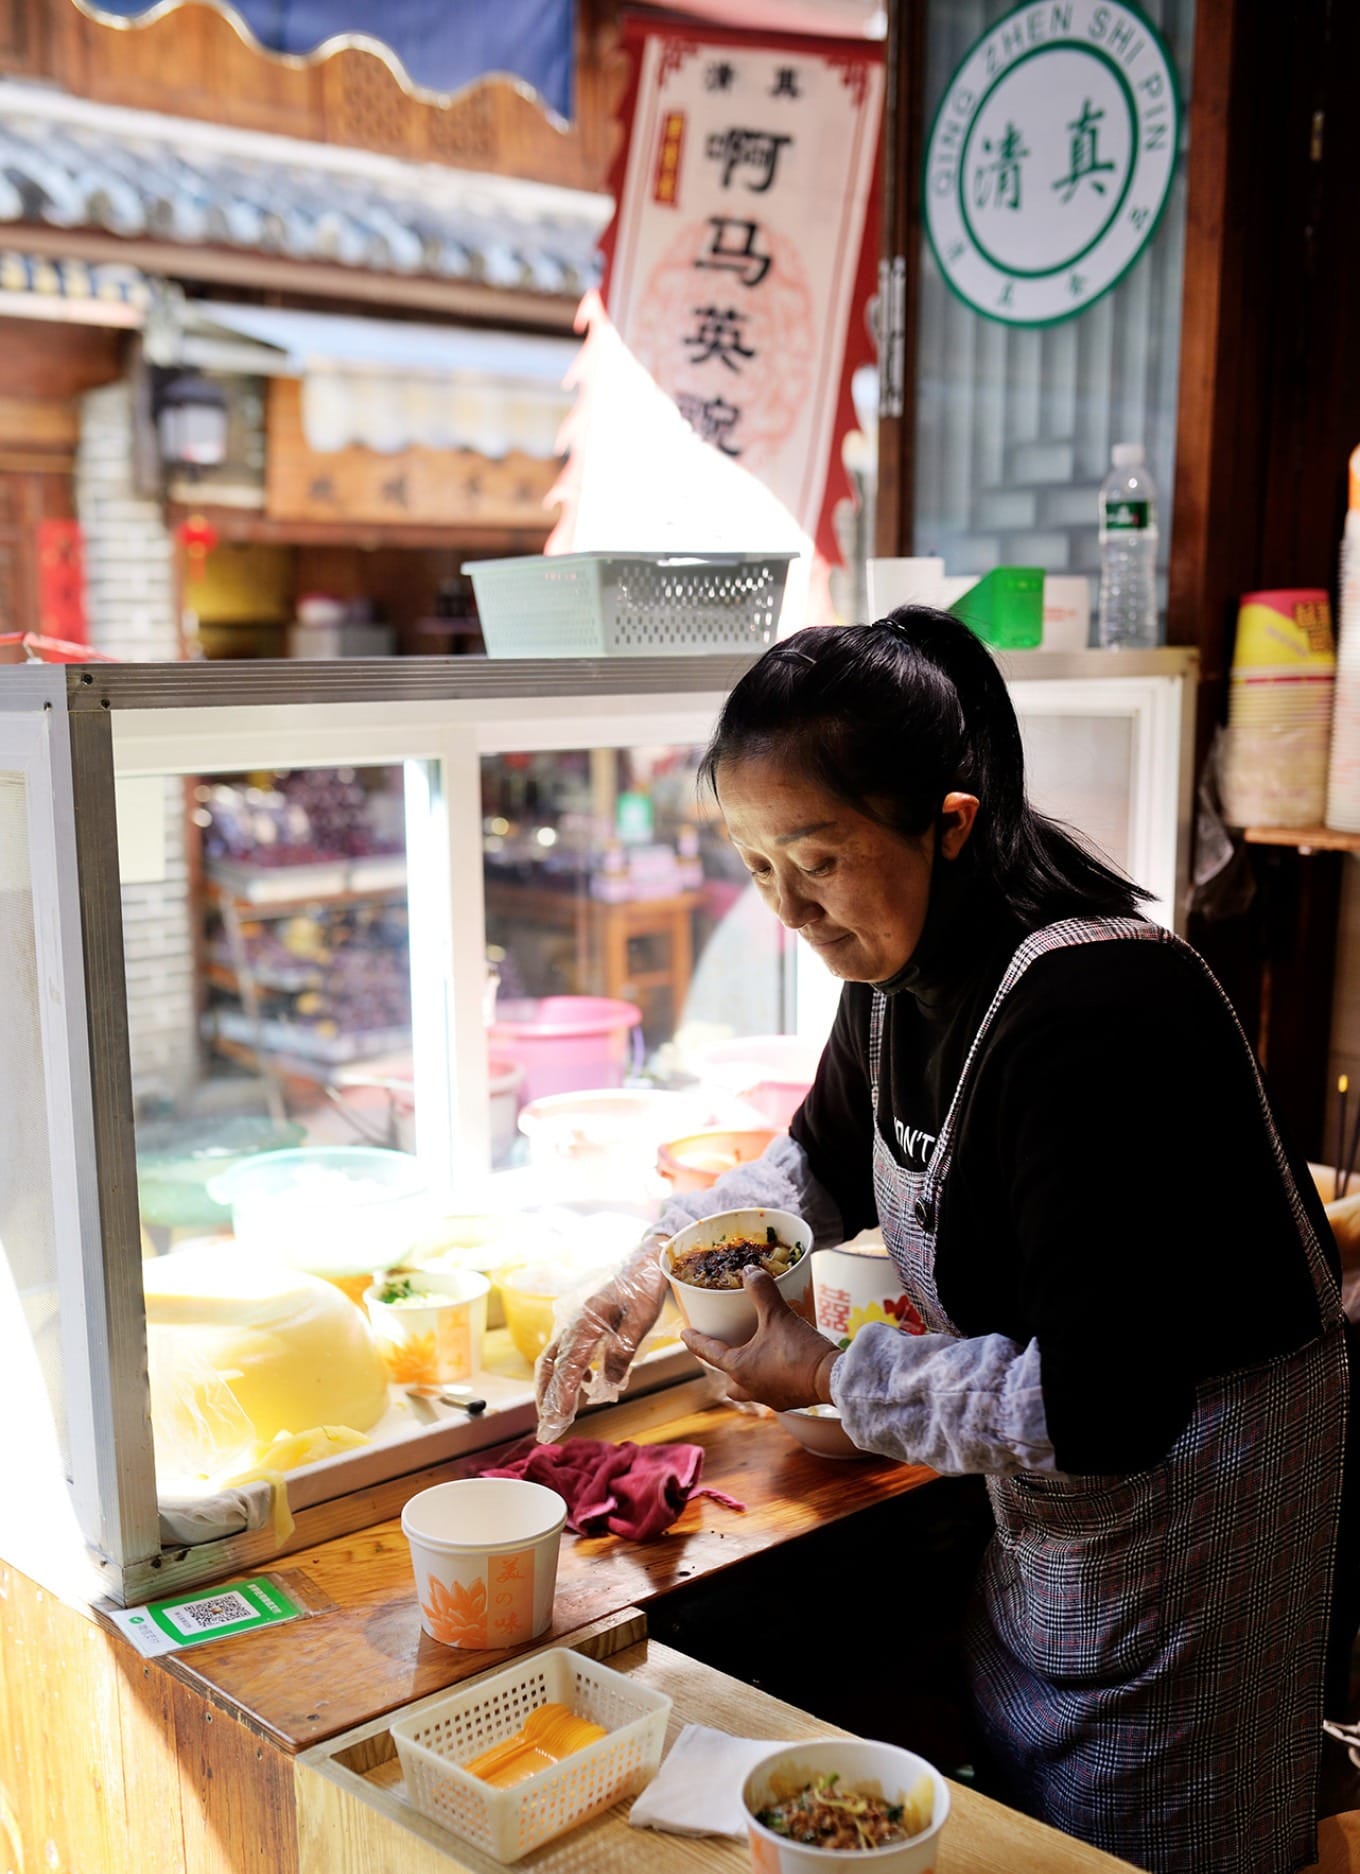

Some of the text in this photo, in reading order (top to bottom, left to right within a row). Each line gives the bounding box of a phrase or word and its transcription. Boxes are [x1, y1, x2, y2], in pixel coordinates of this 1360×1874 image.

[984, 2, 1074, 77] ZHEN
[1088, 6, 1145, 66] SHI
[1139, 71, 1169, 153] PIN
[972, 96, 1117, 213] 清真
